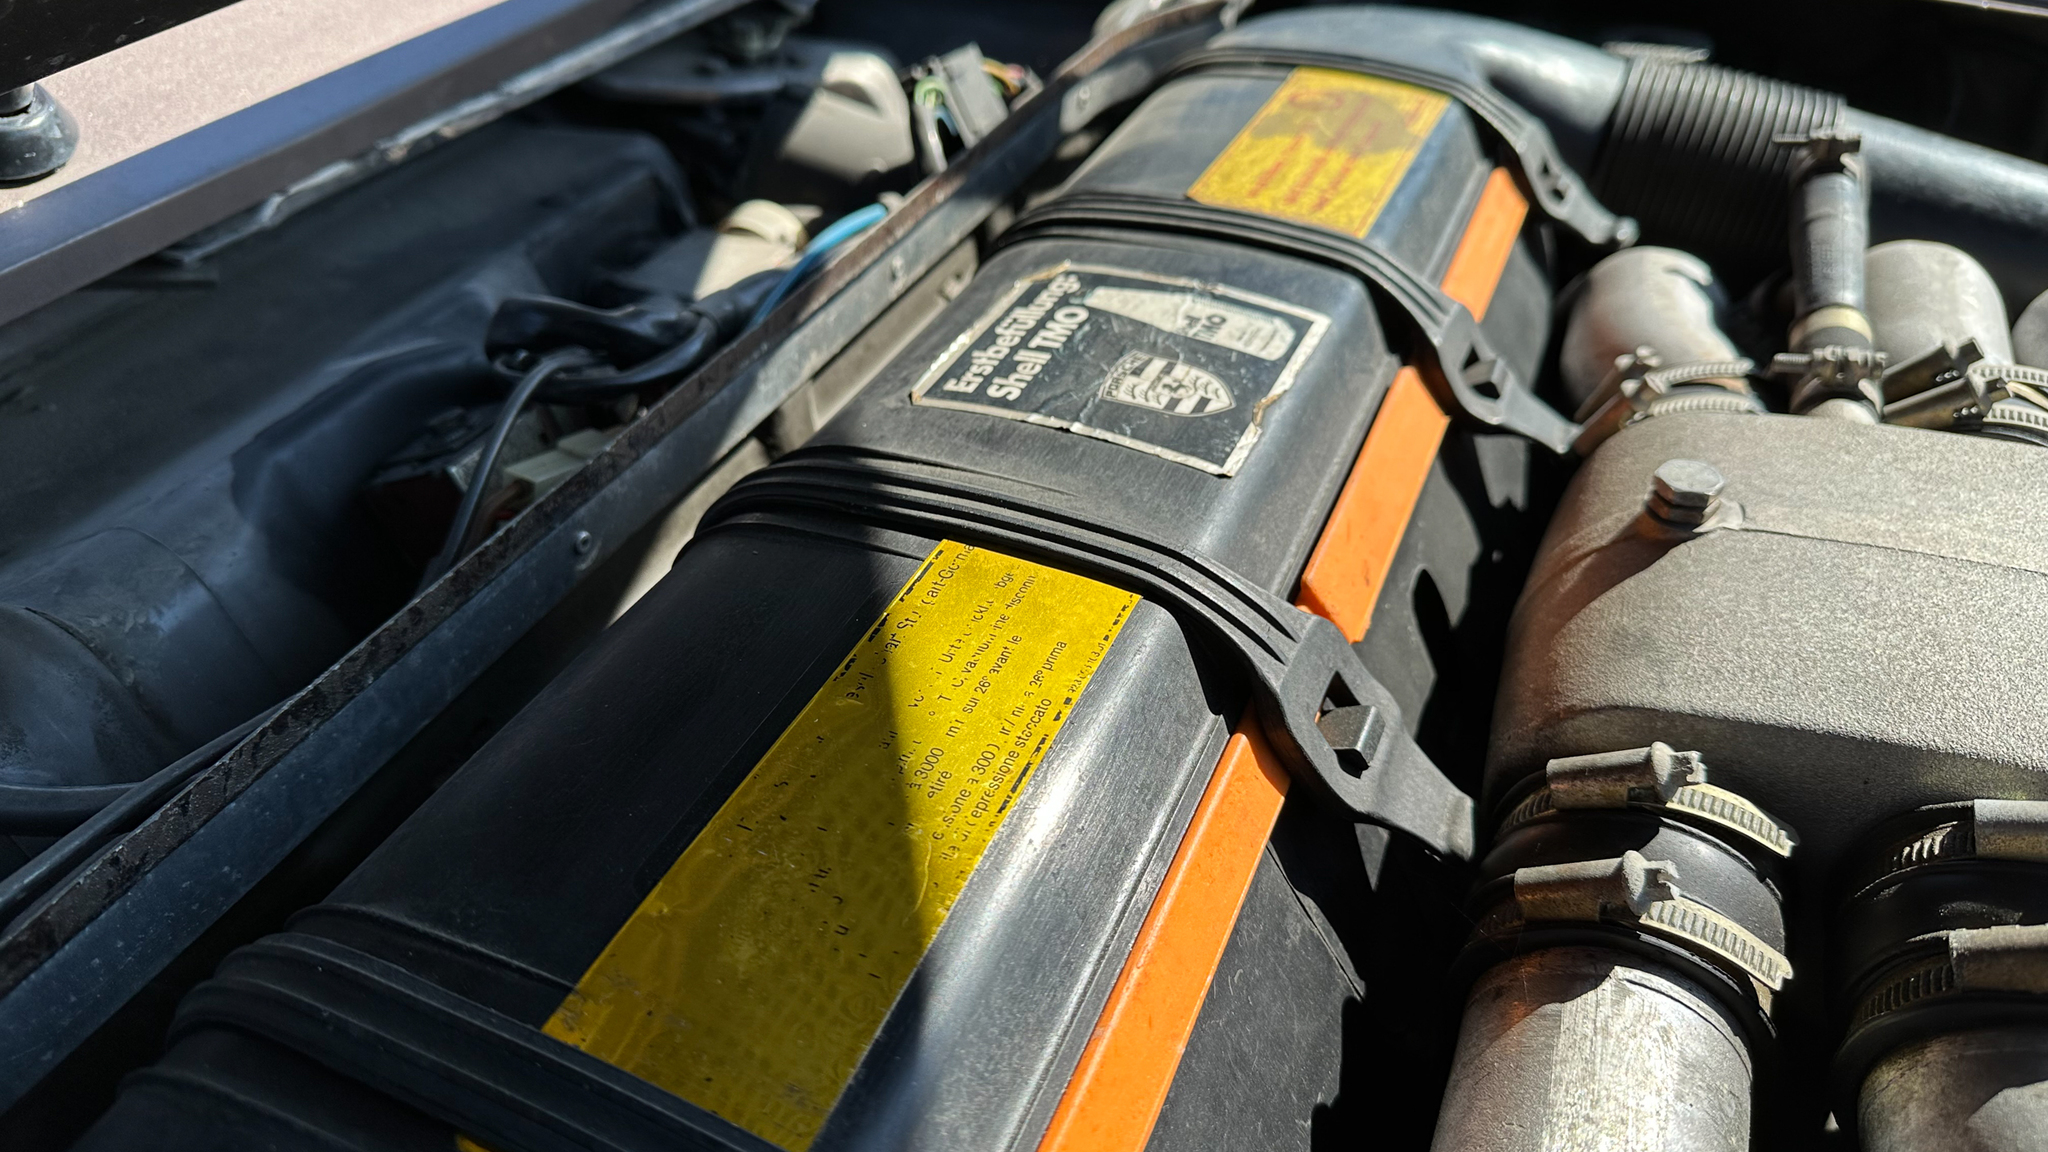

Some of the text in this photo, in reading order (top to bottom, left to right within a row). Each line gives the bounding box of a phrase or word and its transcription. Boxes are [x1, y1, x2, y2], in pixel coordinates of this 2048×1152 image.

[986, 304, 1091, 401] Shell TMO
[1006, 634, 1023, 646] le
[1041, 641, 1068, 673] prima
